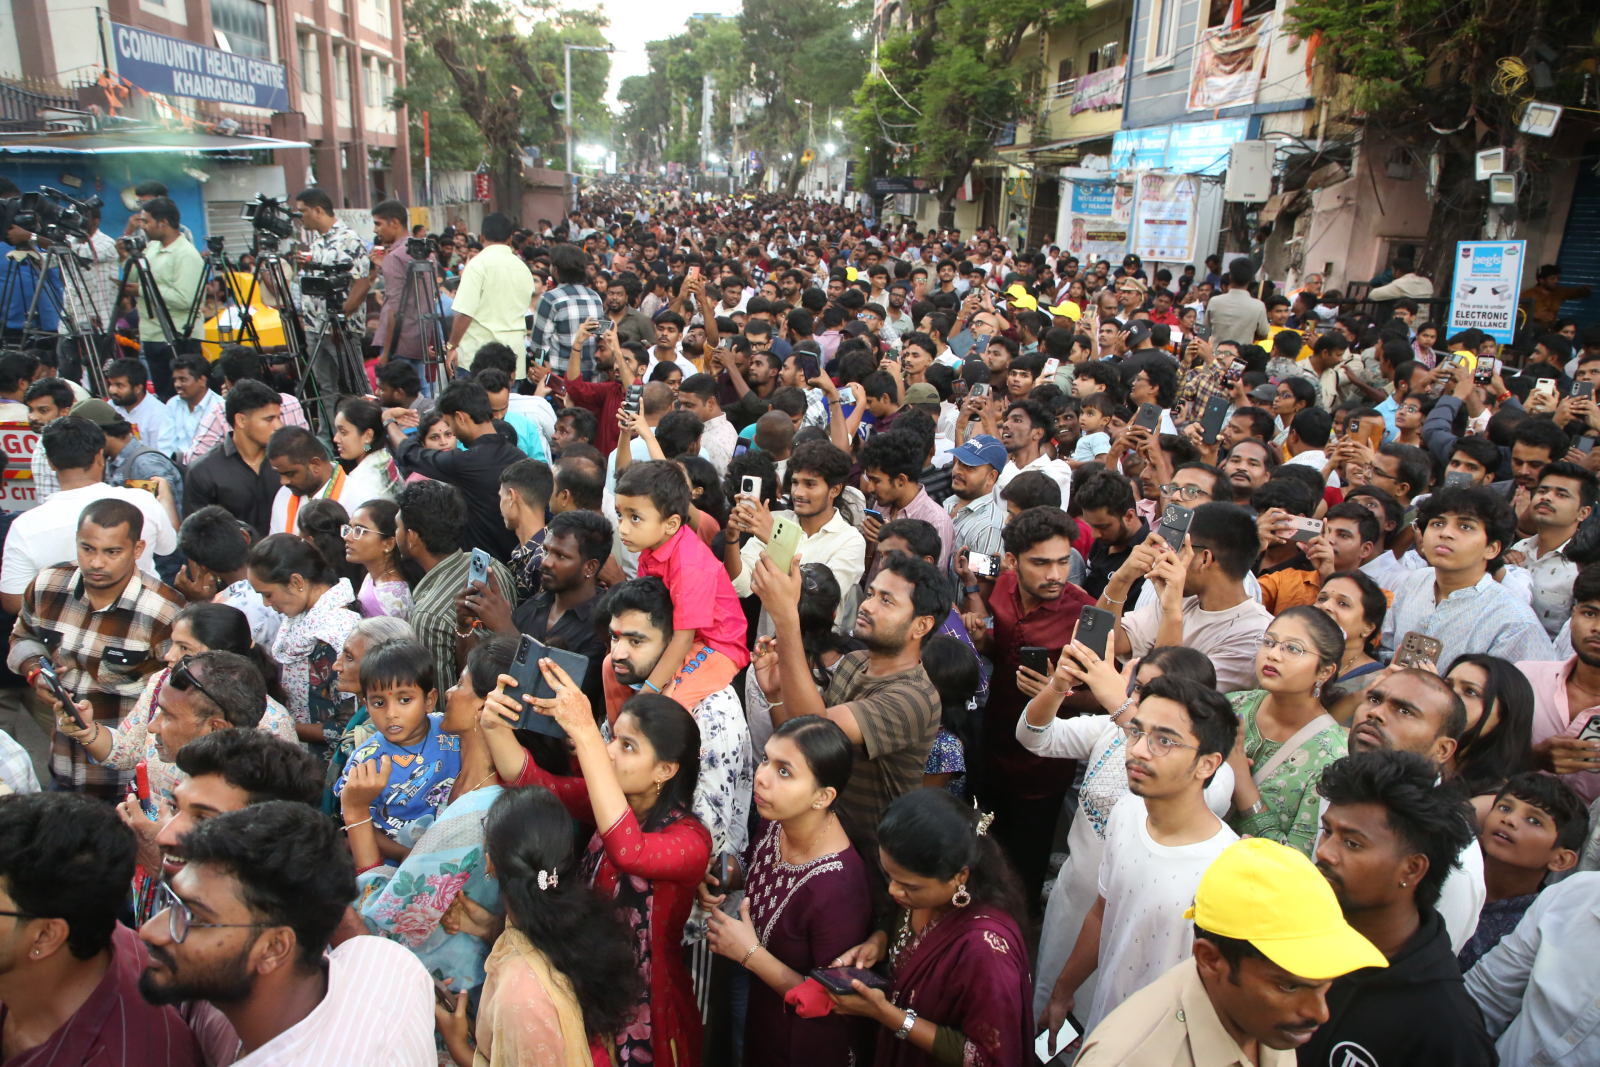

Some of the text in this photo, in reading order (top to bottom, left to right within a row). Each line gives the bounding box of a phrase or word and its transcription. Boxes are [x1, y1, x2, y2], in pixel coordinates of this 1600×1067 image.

[118, 28, 285, 89] COMMUNITY HEALTH CENTRE
[172, 71, 257, 105] KHAIRATABAD
[1454, 320, 1507, 328] SURVEILLANCE
[1455, 310, 1508, 320] ELECTRONIC
[11, 487, 37, 501] CIT
[680, 646, 715, 674] ROCK
